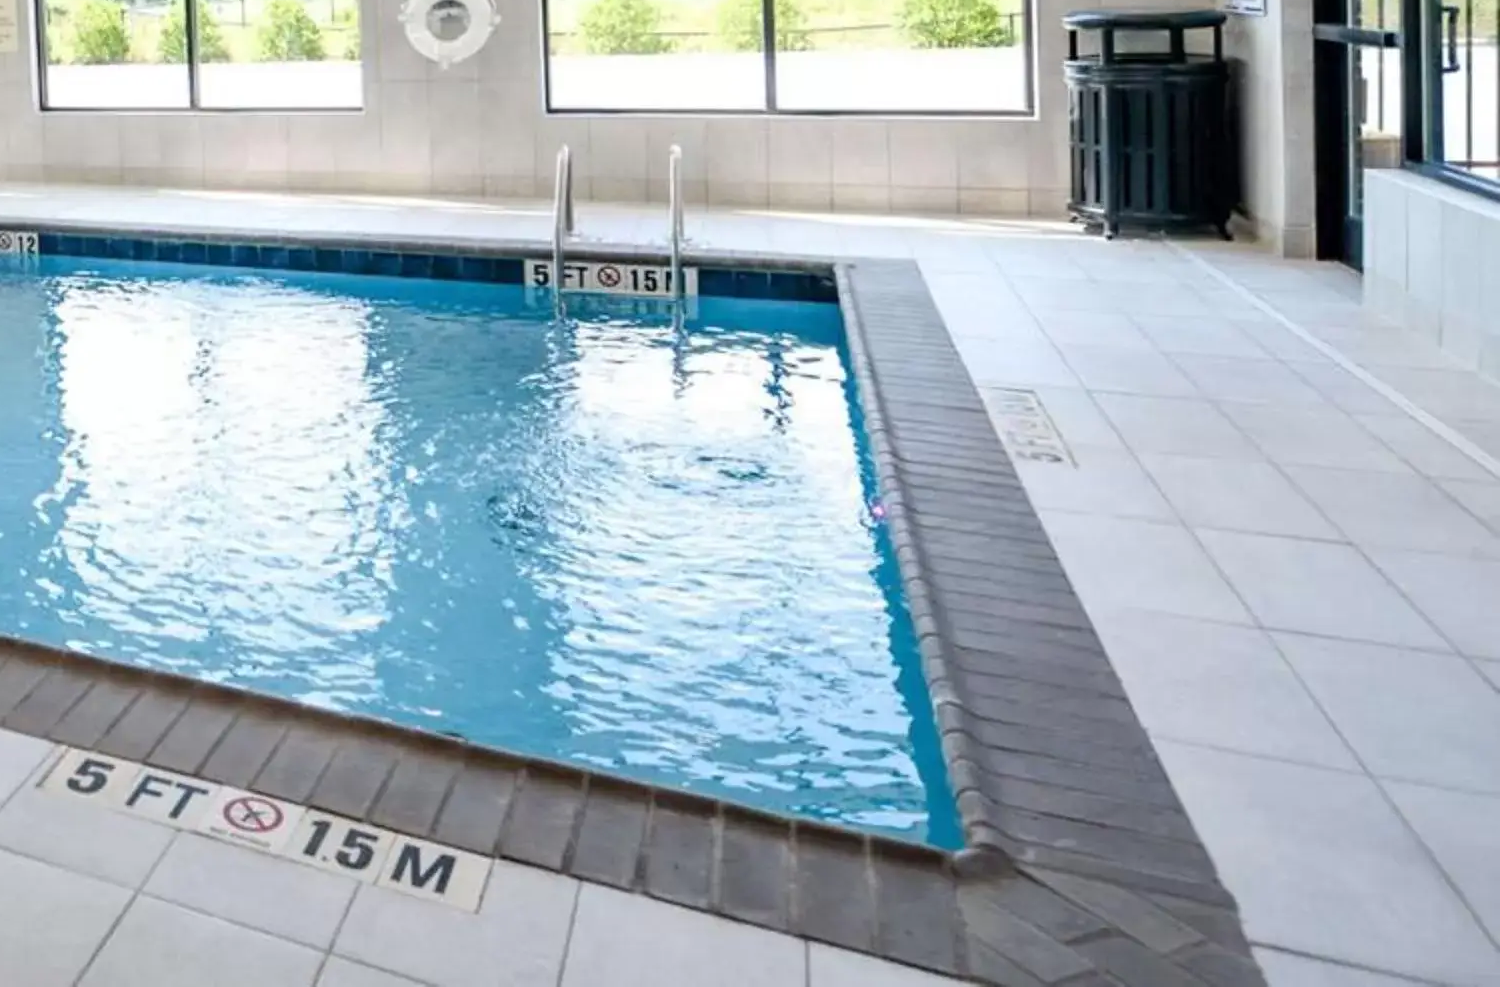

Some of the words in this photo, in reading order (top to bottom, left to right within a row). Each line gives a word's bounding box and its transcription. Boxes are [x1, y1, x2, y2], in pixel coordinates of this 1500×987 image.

[533, 264, 549, 286] 5
[561, 265, 589, 289] FT
[66, 758, 115, 794] 5
[125, 776, 209, 819] FT
